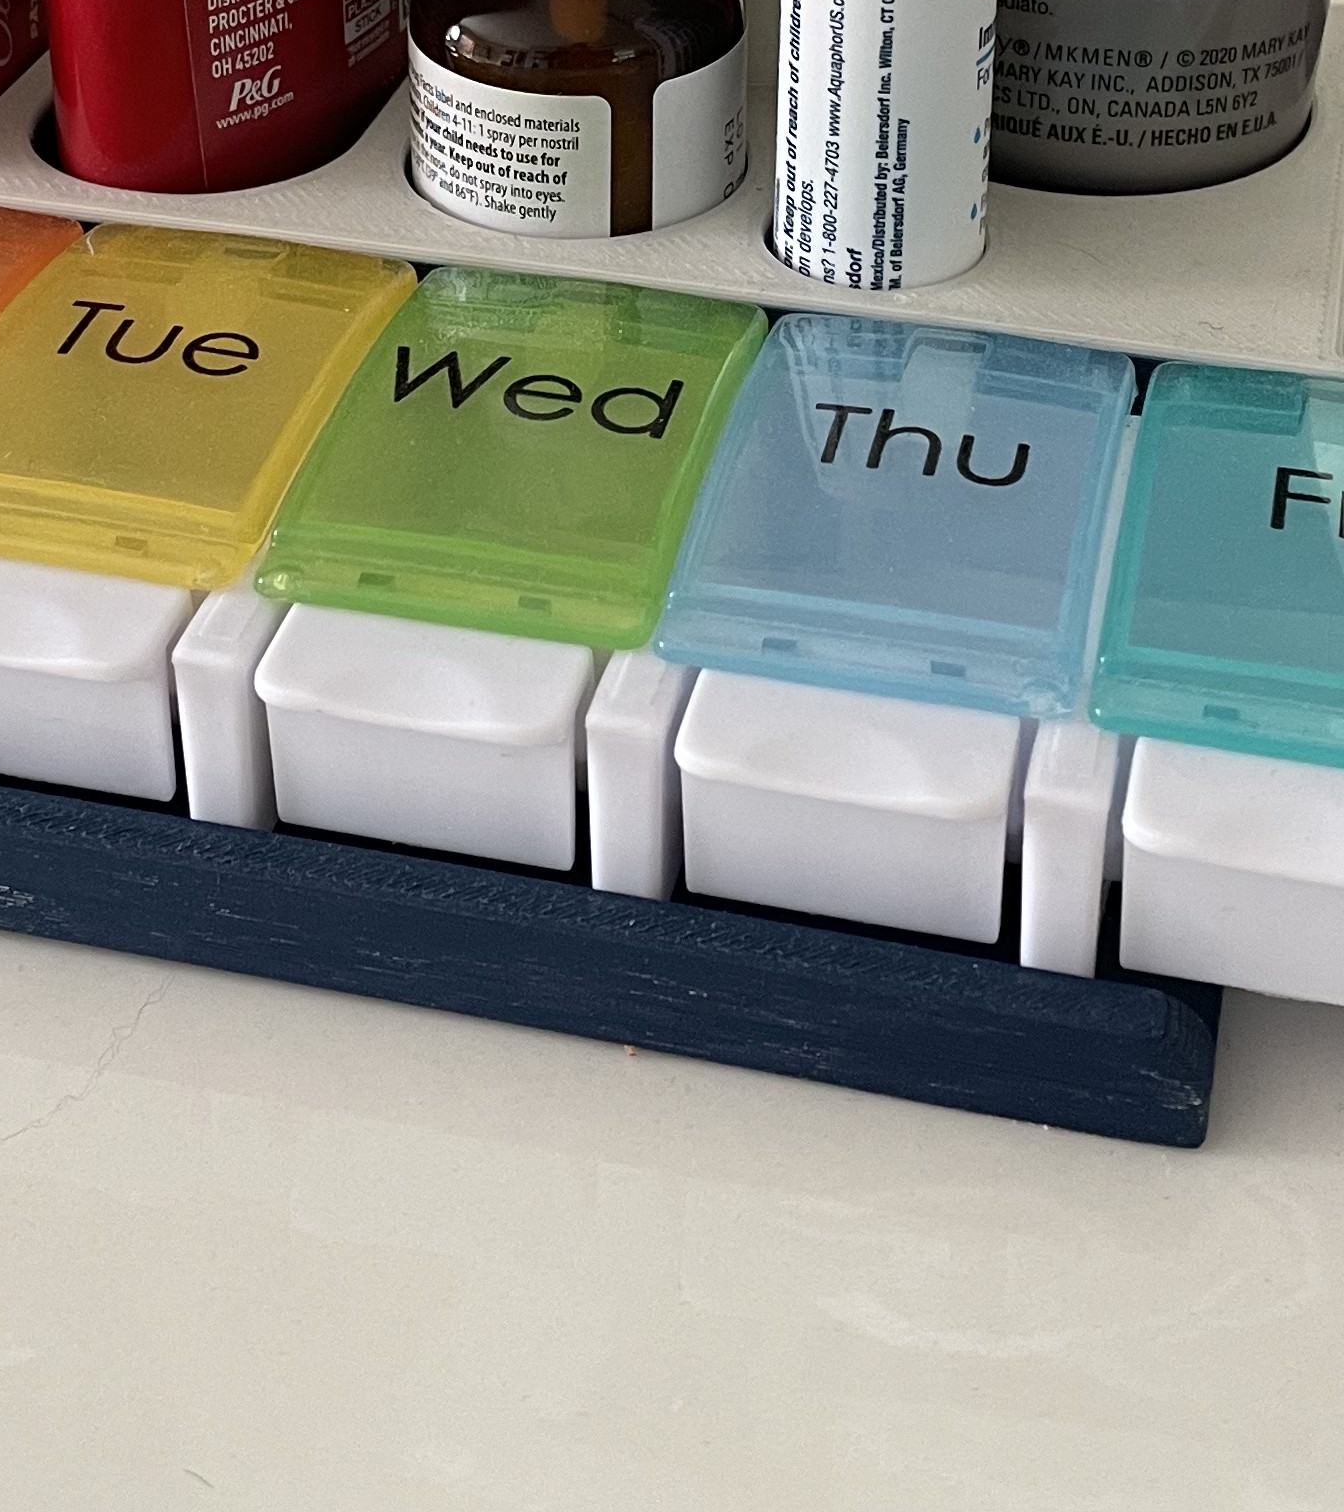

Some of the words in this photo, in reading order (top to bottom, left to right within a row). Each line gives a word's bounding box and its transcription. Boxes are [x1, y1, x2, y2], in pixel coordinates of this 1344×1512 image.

[210, 12, 292, 56] CINCINNATI,
[882, 7, 894, 23] CT
[212, 57, 232, 78] OH
[235, 41, 274, 70] 45202
[880, 27, 895, 69] Wilton,
[229, 65, 282, 112] P&G
[788, 61, 799, 84] of
[878, 72, 892, 94] Inc.
[216, 91, 294, 129] www.pg.com
[455, 100, 472, 115] and
[475, 108, 521, 128] enclosed
[524, 118, 580, 133] materials
[786, 86, 798, 137] reach
[466, 139, 498, 158] needs
[500, 148, 514, 161] to
[516, 152, 538, 165] use
[540, 152, 561, 167] for
[487, 129, 516, 147] spray
[519, 135, 538, 149] per
[541, 137, 579, 151] nostril
[785, 136, 798, 160] of
[449, 146, 473, 170] Keep
[475, 161, 496, 175] out
[498, 165, 511, 179] of
[513, 169, 550, 184] reach
[553, 171, 568, 186] of
[449, 164, 460, 180] do
[462, 173, 478, 187] not
[480, 179, 508, 198] spray
[511, 184, 533, 200] into
[535, 191, 566, 204] eyes.
[785, 160, 796, 192] out
[874, 162, 891, 180] by:
[783, 194, 797, 240] Keep
[797, 179, 816, 253] develops.
[821, 140, 840, 254] 1-800-227-4703
[57, 300, 259, 376] Tue
[393, 346, 685, 439] Wed
[815, 402, 1032, 487] Thu
